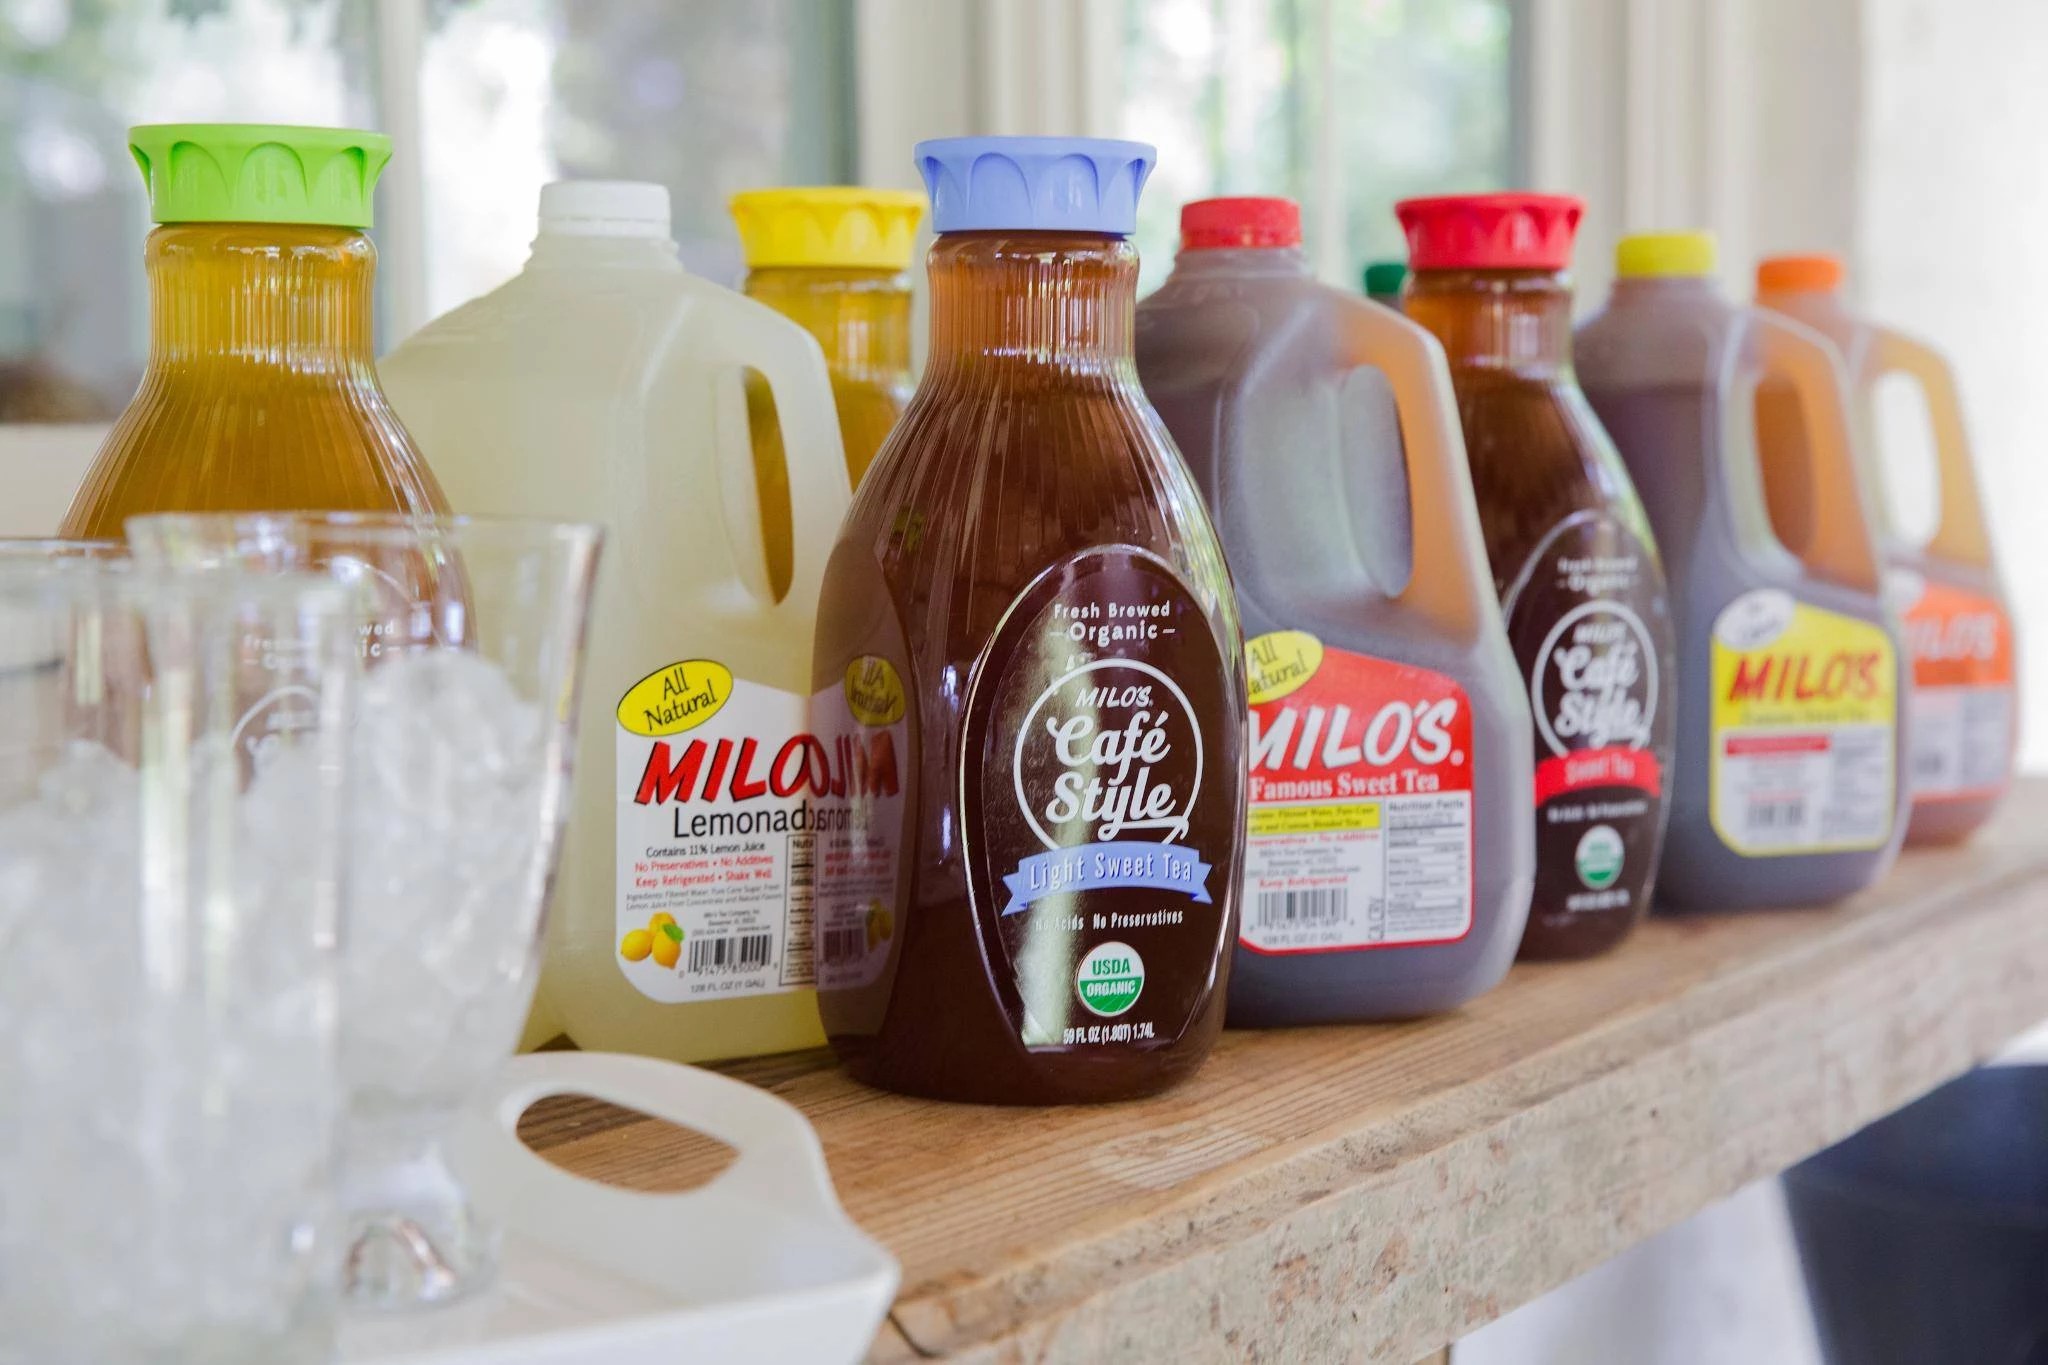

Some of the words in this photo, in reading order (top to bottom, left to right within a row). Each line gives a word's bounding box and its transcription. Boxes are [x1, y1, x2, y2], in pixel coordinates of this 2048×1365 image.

[1054, 602, 1100, 619] Fresh
[1109, 601, 1171, 618] Brewed
[1069, 620, 1158, 648] Organic
[1251, 635, 1281, 669] All
[663, 666, 690, 701] All
[1248, 648, 1309, 696] atural
[1726, 649, 1881, 706] MILO'S
[643, 678, 719, 732] Natural
[1075, 685, 1153, 709] MILO'S
[1046, 710, 1171, 786] Café
[1248, 697, 1459, 771] MILO'S
[634, 733, 810, 806] MILO
[1249, 776, 1334, 800] Famous
[1337, 770, 1398, 797] Sweet
[1402, 768, 1440, 791] Tea
[674, 799, 807, 839] Lemonad
[1046, 767, 1189, 841] Style
[635, 862, 648, 873] No
[651, 859, 709, 872] Preservatives
[720, 857, 732, 866] No
[646, 846, 687, 858] Contains
[690, 844, 708, 856] 11%
[711, 843, 740, 854] Lemon
[744, 841, 766, 852] Juice
[636, 878, 658, 889] Keep
[662, 873, 715, 888] Refrigerated
[1030, 857, 1085, 891] Light
[1095, 852, 1154, 879] Sweet
[1163, 852, 1192, 882] Tea
[1093, 912, 1107, 930] No
[1111, 908, 1183, 929] Preservatives
[1092, 957, 1131, 976] USDA
[1086, 980, 1136, 998] ORGANIC
[1076, 1026, 1087, 1044] FL
[1088, 1025, 1100, 1043] OZ
